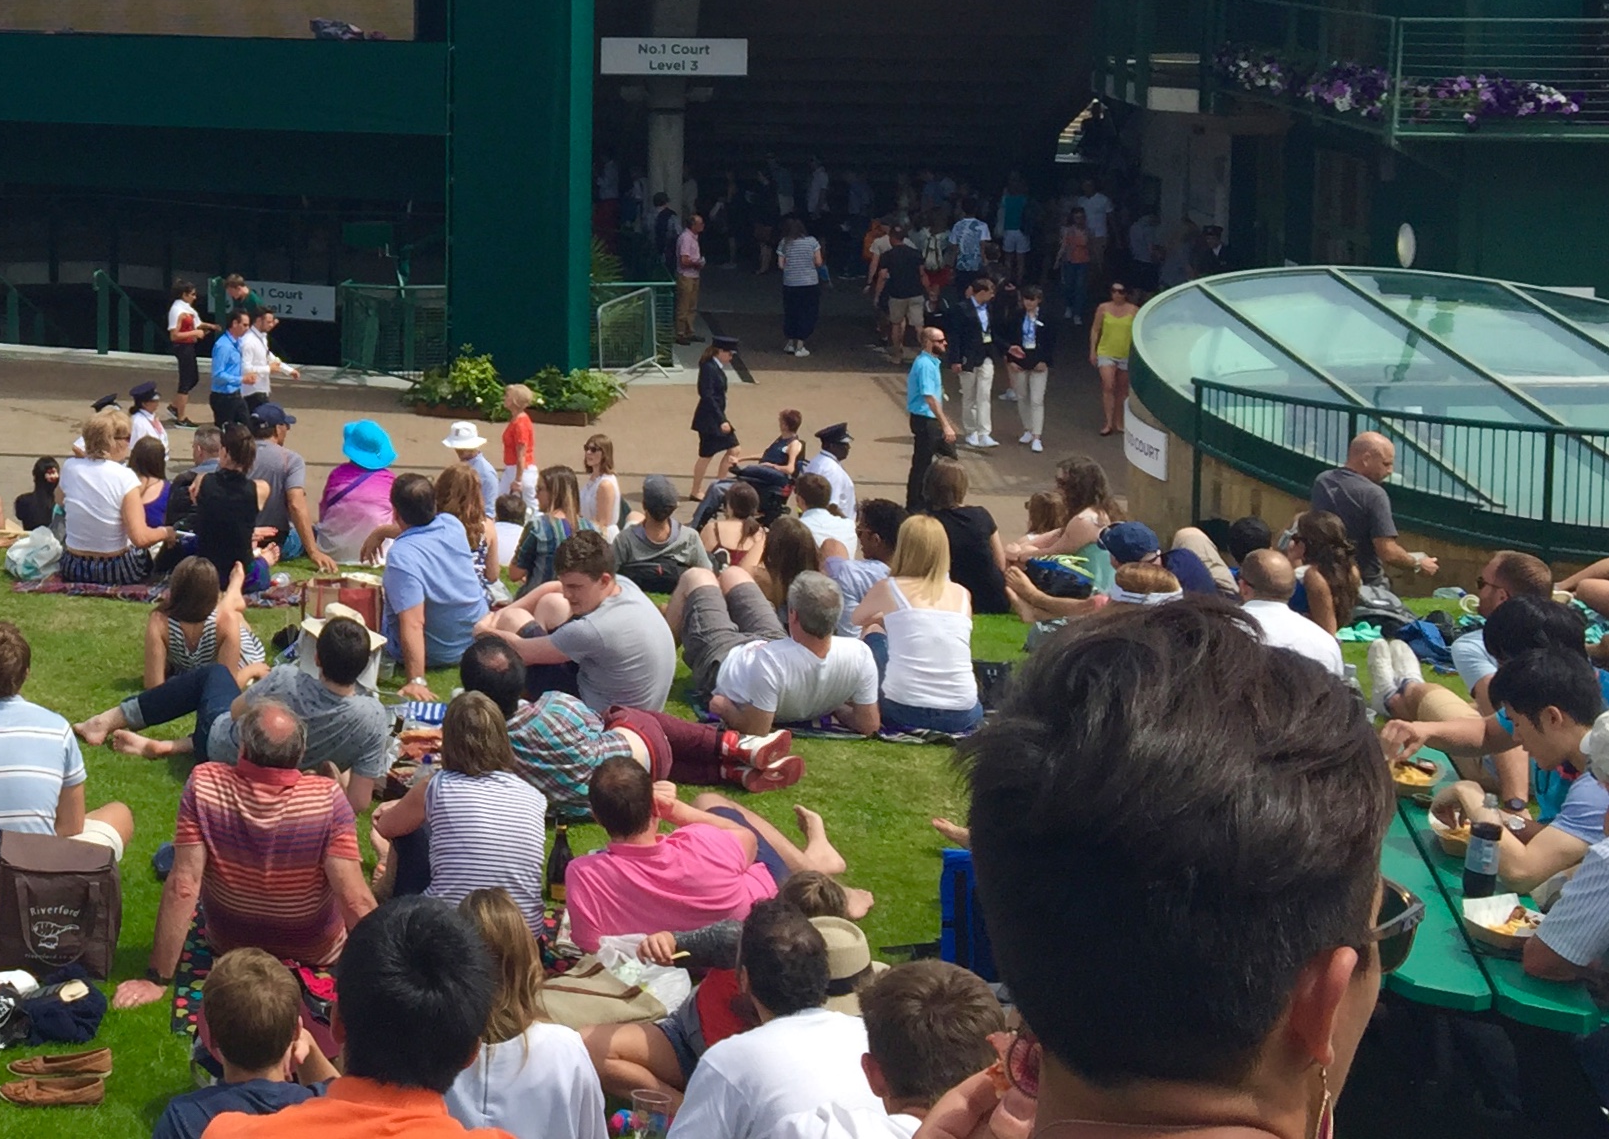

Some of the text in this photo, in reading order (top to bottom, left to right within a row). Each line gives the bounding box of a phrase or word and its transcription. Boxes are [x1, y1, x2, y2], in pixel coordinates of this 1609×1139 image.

[638, 44, 710, 55] No.1 Court
[649, 60, 698, 71] Level 3
[268, 288, 303, 300] Court
[285, 304, 293, 314] 2
[30, 905, 80, 917] Riverford
